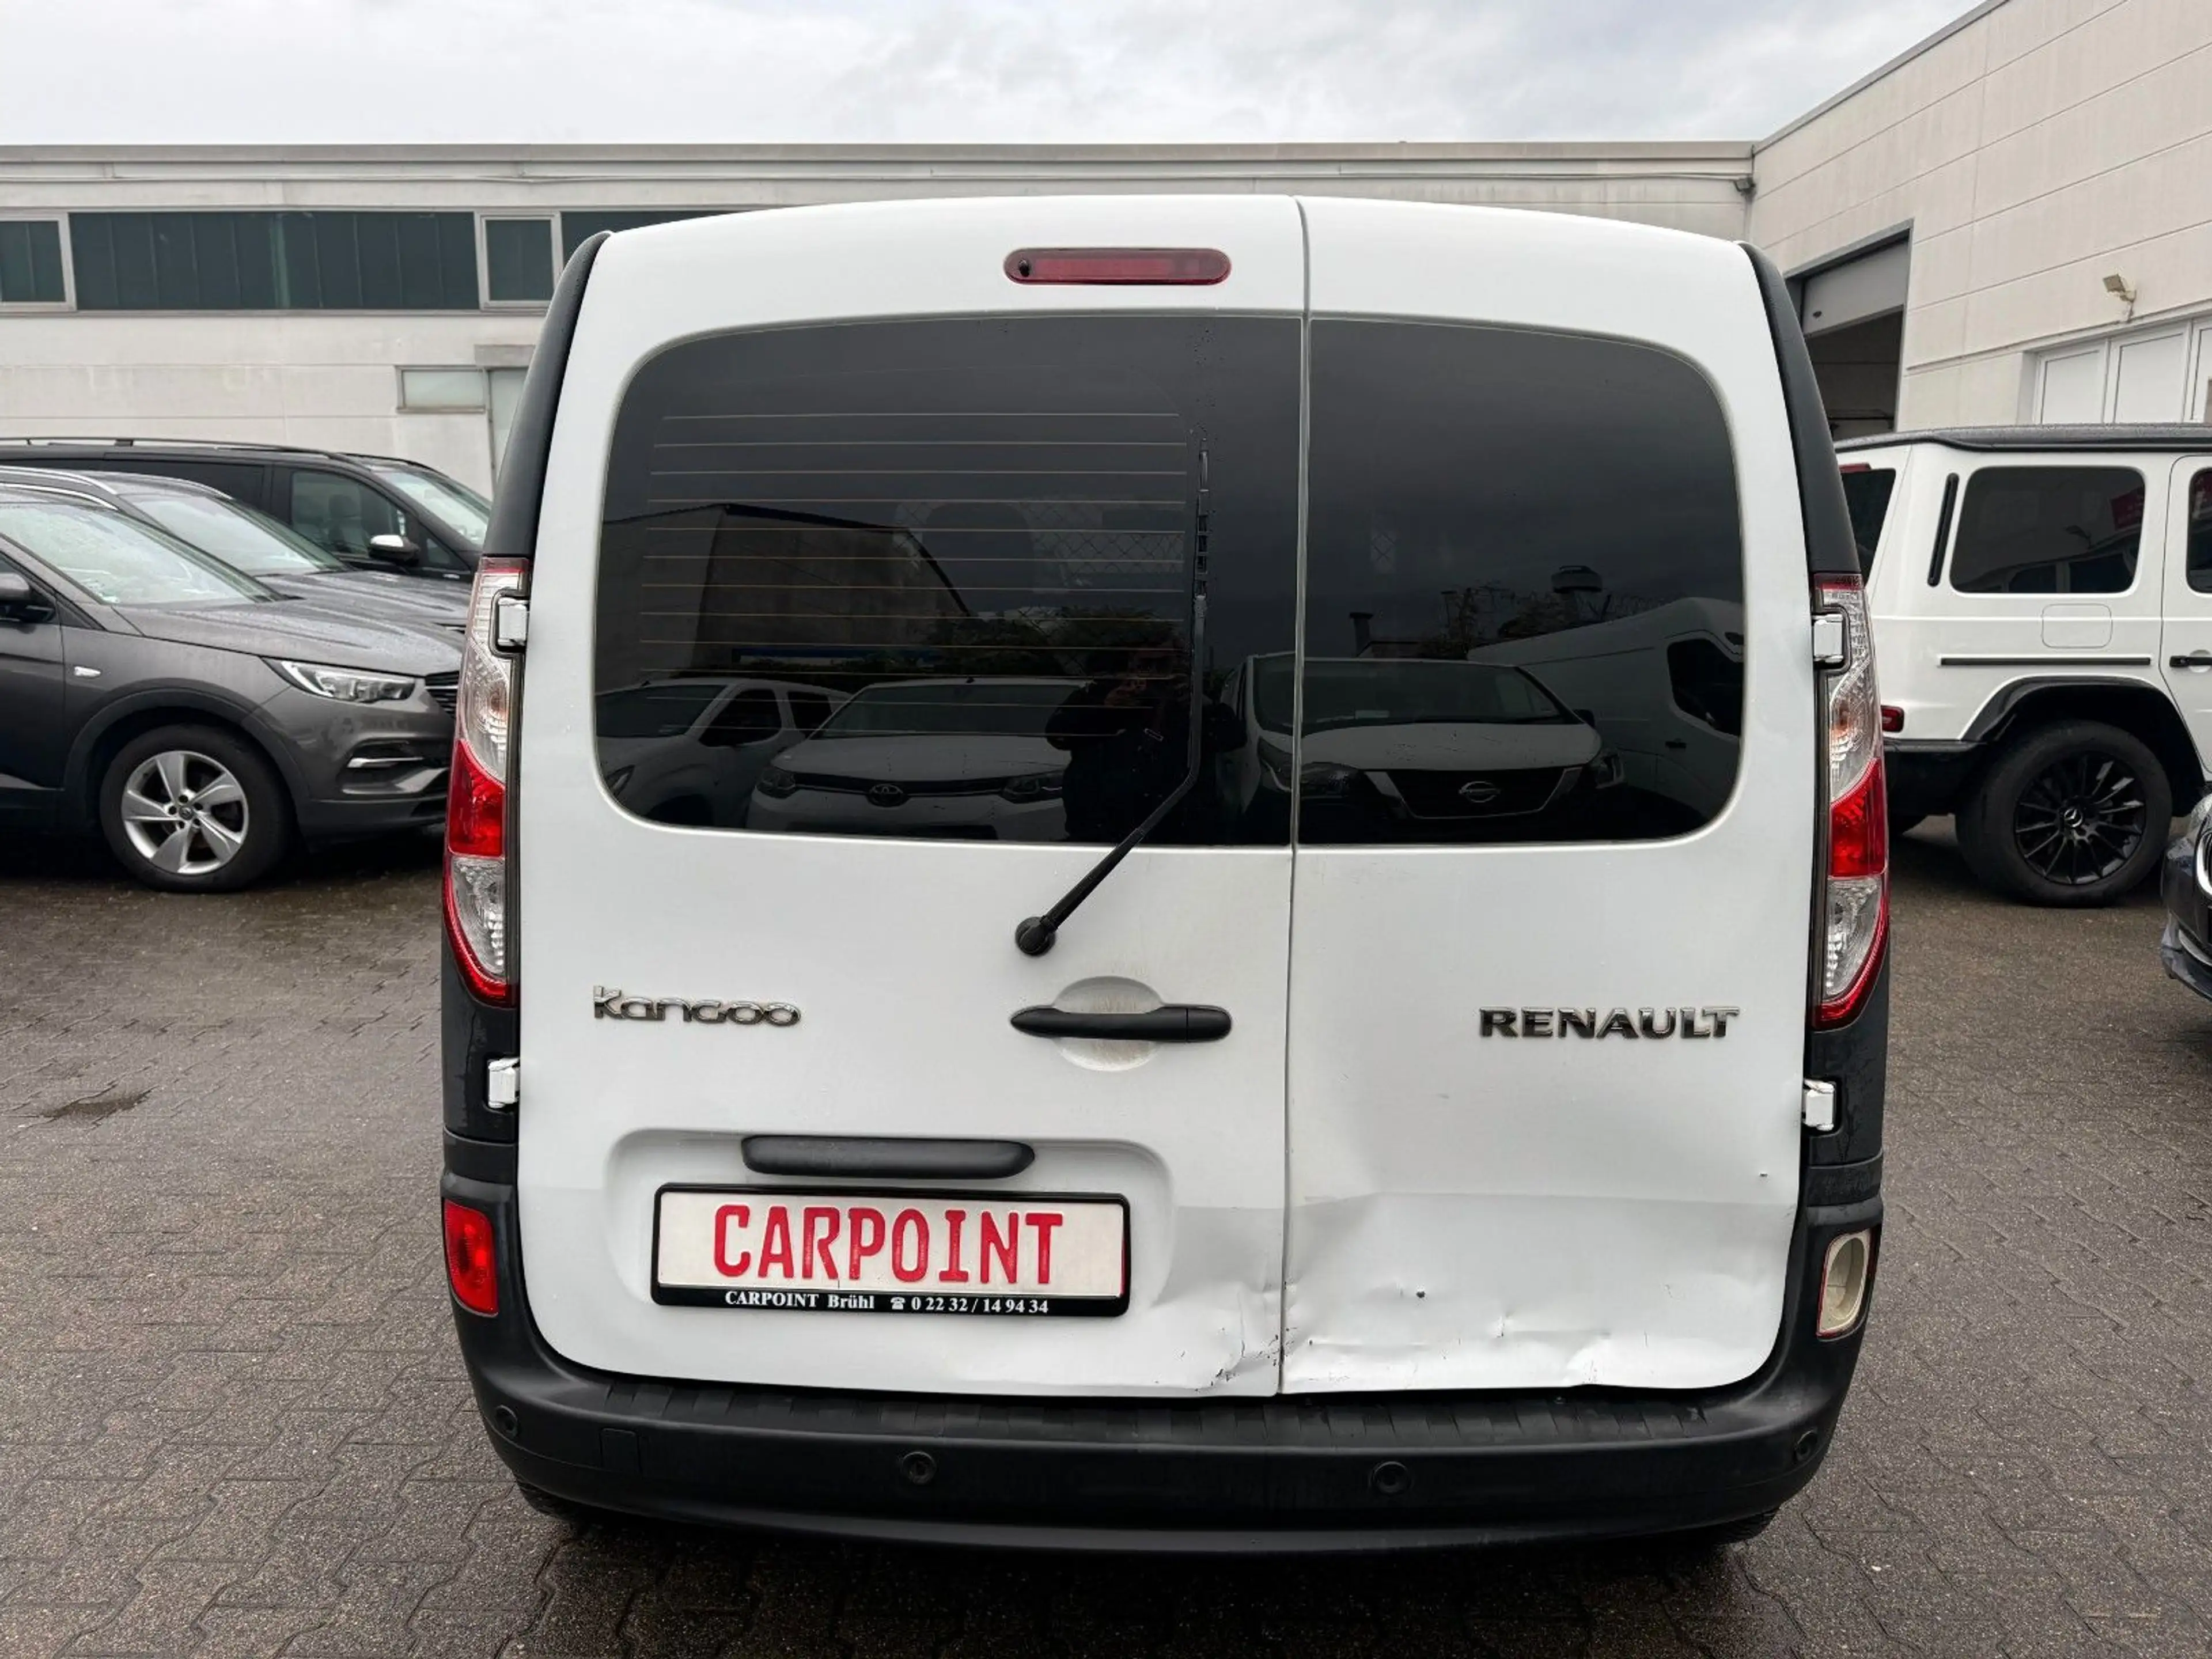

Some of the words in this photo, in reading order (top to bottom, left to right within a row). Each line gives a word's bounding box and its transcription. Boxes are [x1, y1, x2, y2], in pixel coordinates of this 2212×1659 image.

[1479, 1006, 1740, 1039] RENAULT
[714, 1204, 1063, 1284] CARPOINT
[725, 1291, 819, 1308] CARPOINT
[827, 1294, 875, 1309] Brühl
[911, 1297, 922, 1310] 0
[926, 1297, 945, 1310] 22
[948, 1297, 968, 1312] 32
[983, 1298, 1001, 1313] 14
[1005, 1299, 1025, 1313] 94
[1028, 1299, 1049, 1313] 34
